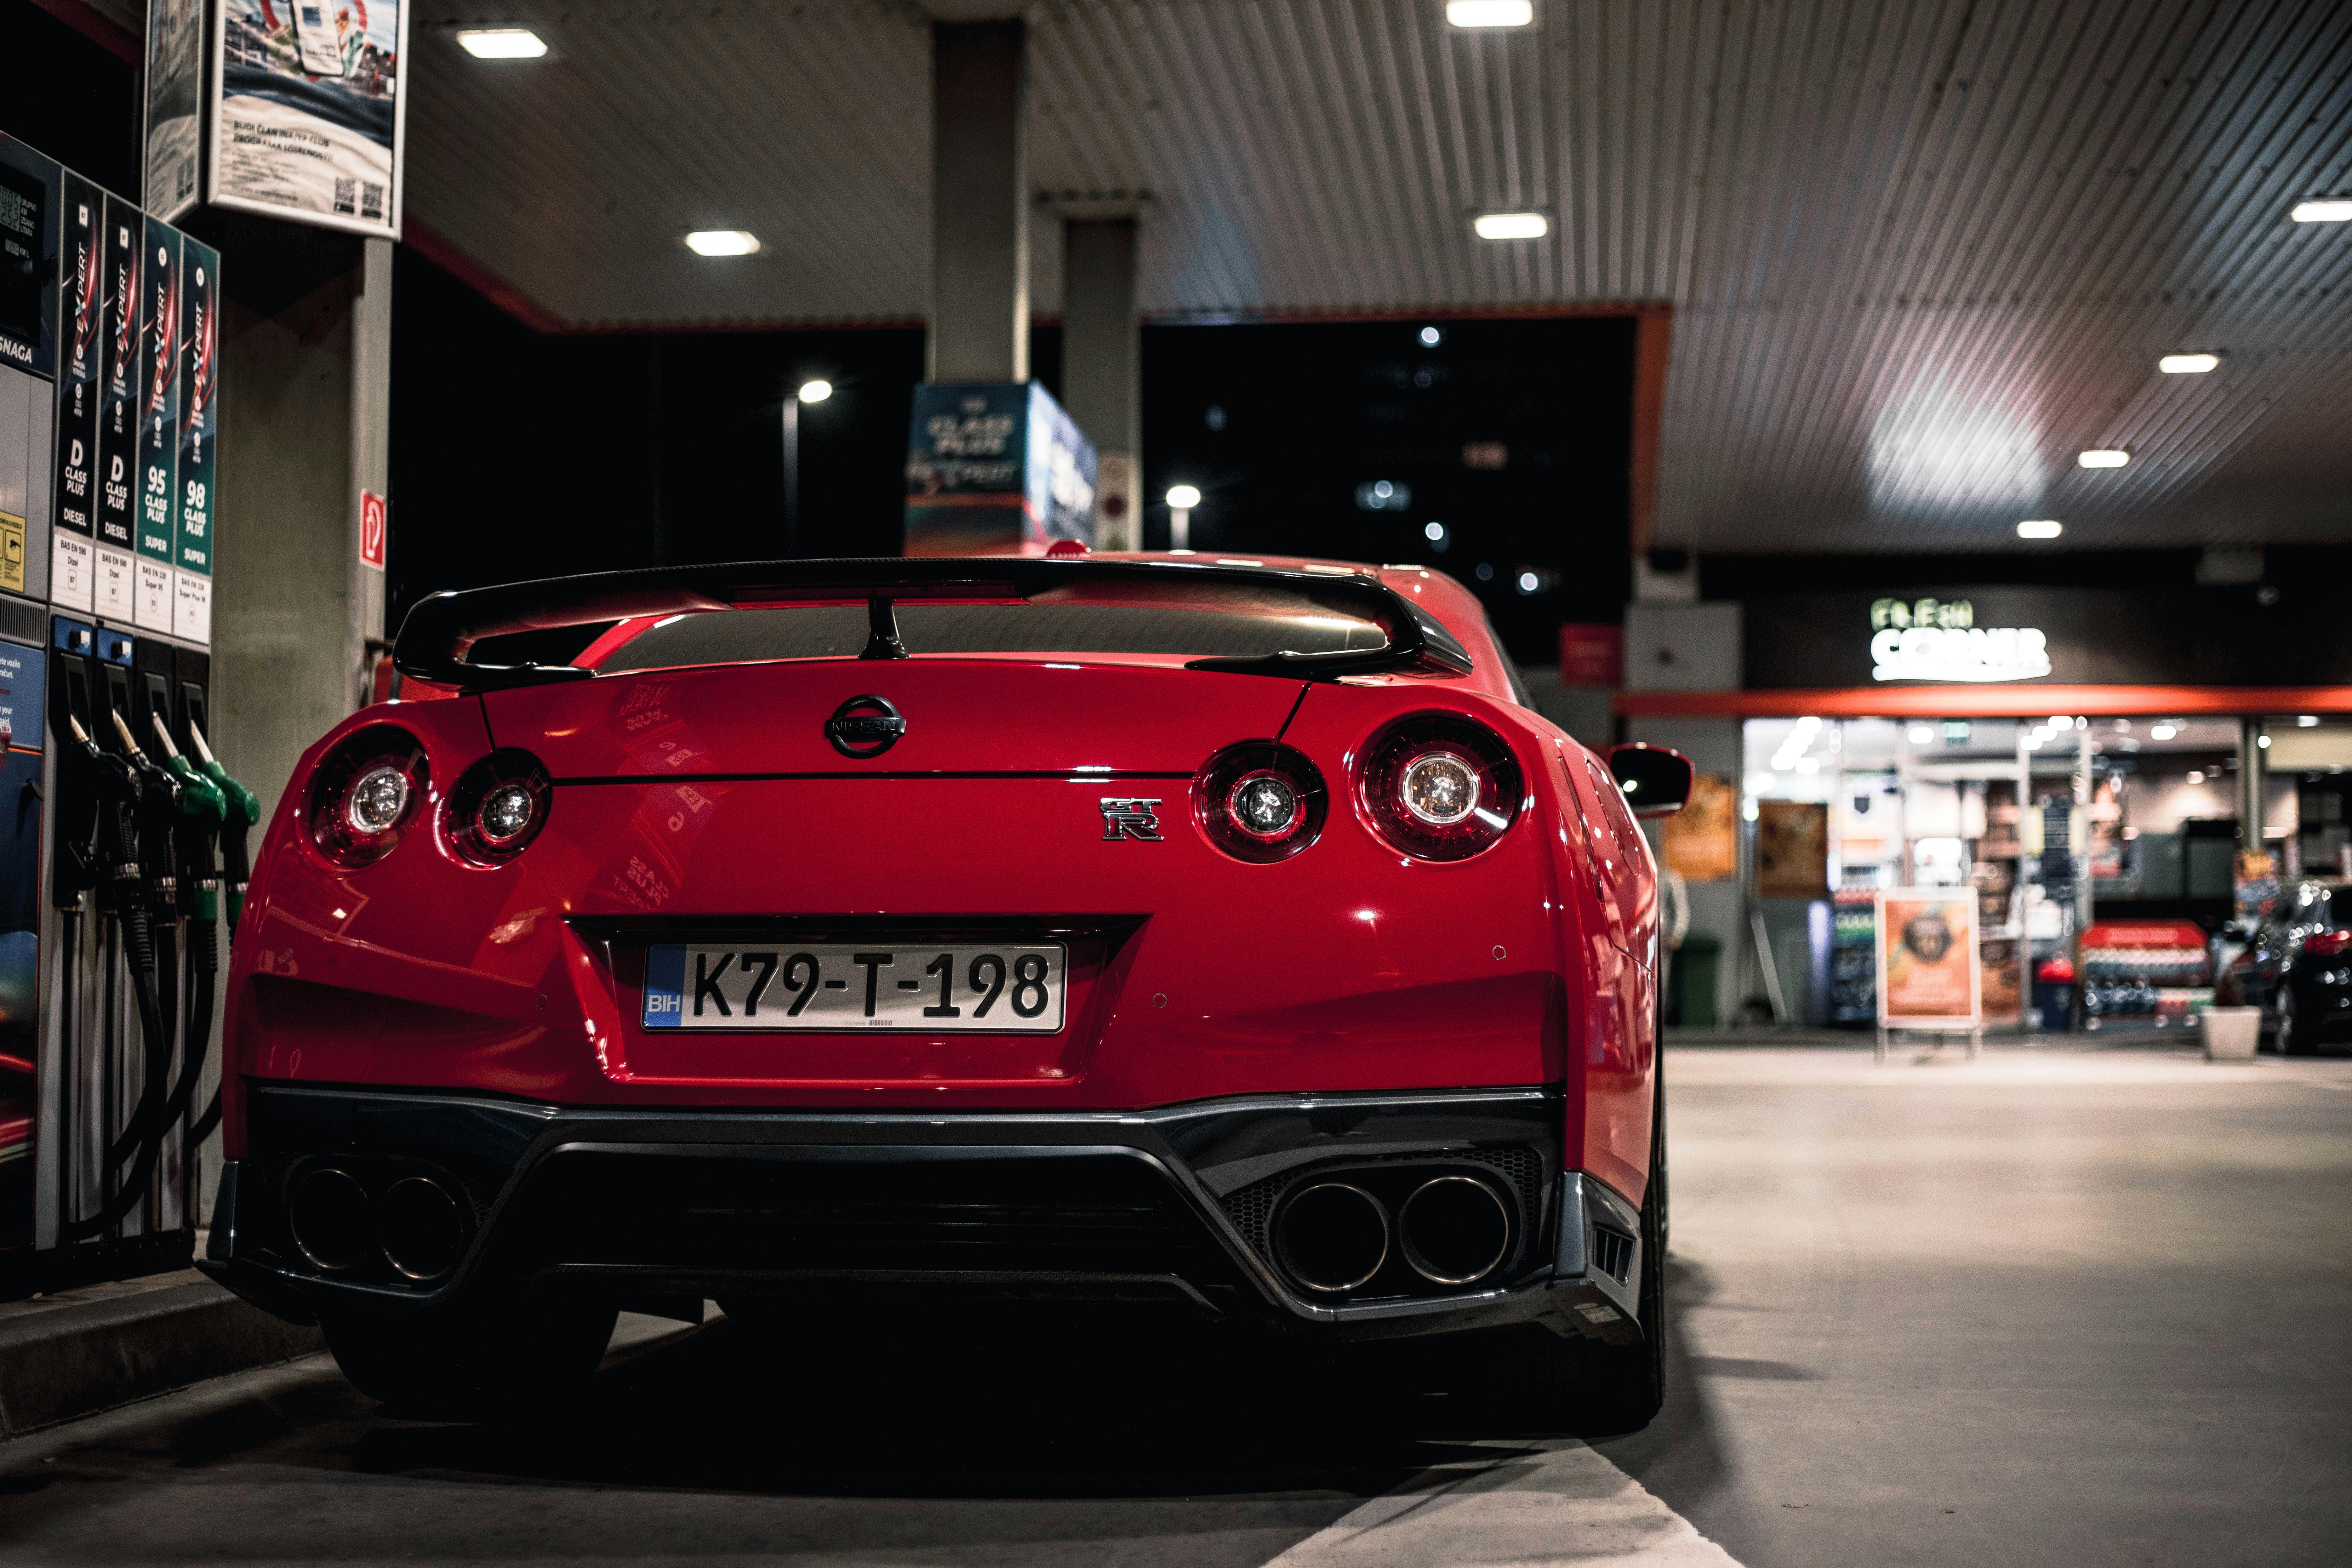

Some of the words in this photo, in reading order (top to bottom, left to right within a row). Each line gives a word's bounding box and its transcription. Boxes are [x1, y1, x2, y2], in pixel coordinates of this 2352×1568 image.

[0, 336, 32, 364] SNAGA
[70, 439, 83, 467] D
[65, 466, 87, 485] CLASS
[110, 454, 124, 482] D
[67, 479, 84, 496] PLUS
[106, 480, 127, 499] CLASS
[148, 465, 166, 495] 95
[107, 494, 125, 512] PLUS
[145, 494, 167, 512] CLASS
[186, 479, 206, 509] 98
[64, 507, 87, 527] DIESEL
[147, 507, 165, 524] PLUS
[184, 507, 206, 526] CLASS
[105, 521, 127, 541] DIESEL
[186, 520, 204, 538] PLUS
[61, 539, 70, 550] BAS
[72, 543, 78, 552] EN
[145, 535, 167, 553] SUPER
[102, 553, 112, 564] BAS
[184, 547, 206, 566] SUPER
[832, 721, 897, 731] NISSAN
[694, 952, 1049, 1017] K79-T-198
[648, 994, 681, 1013] BIH
